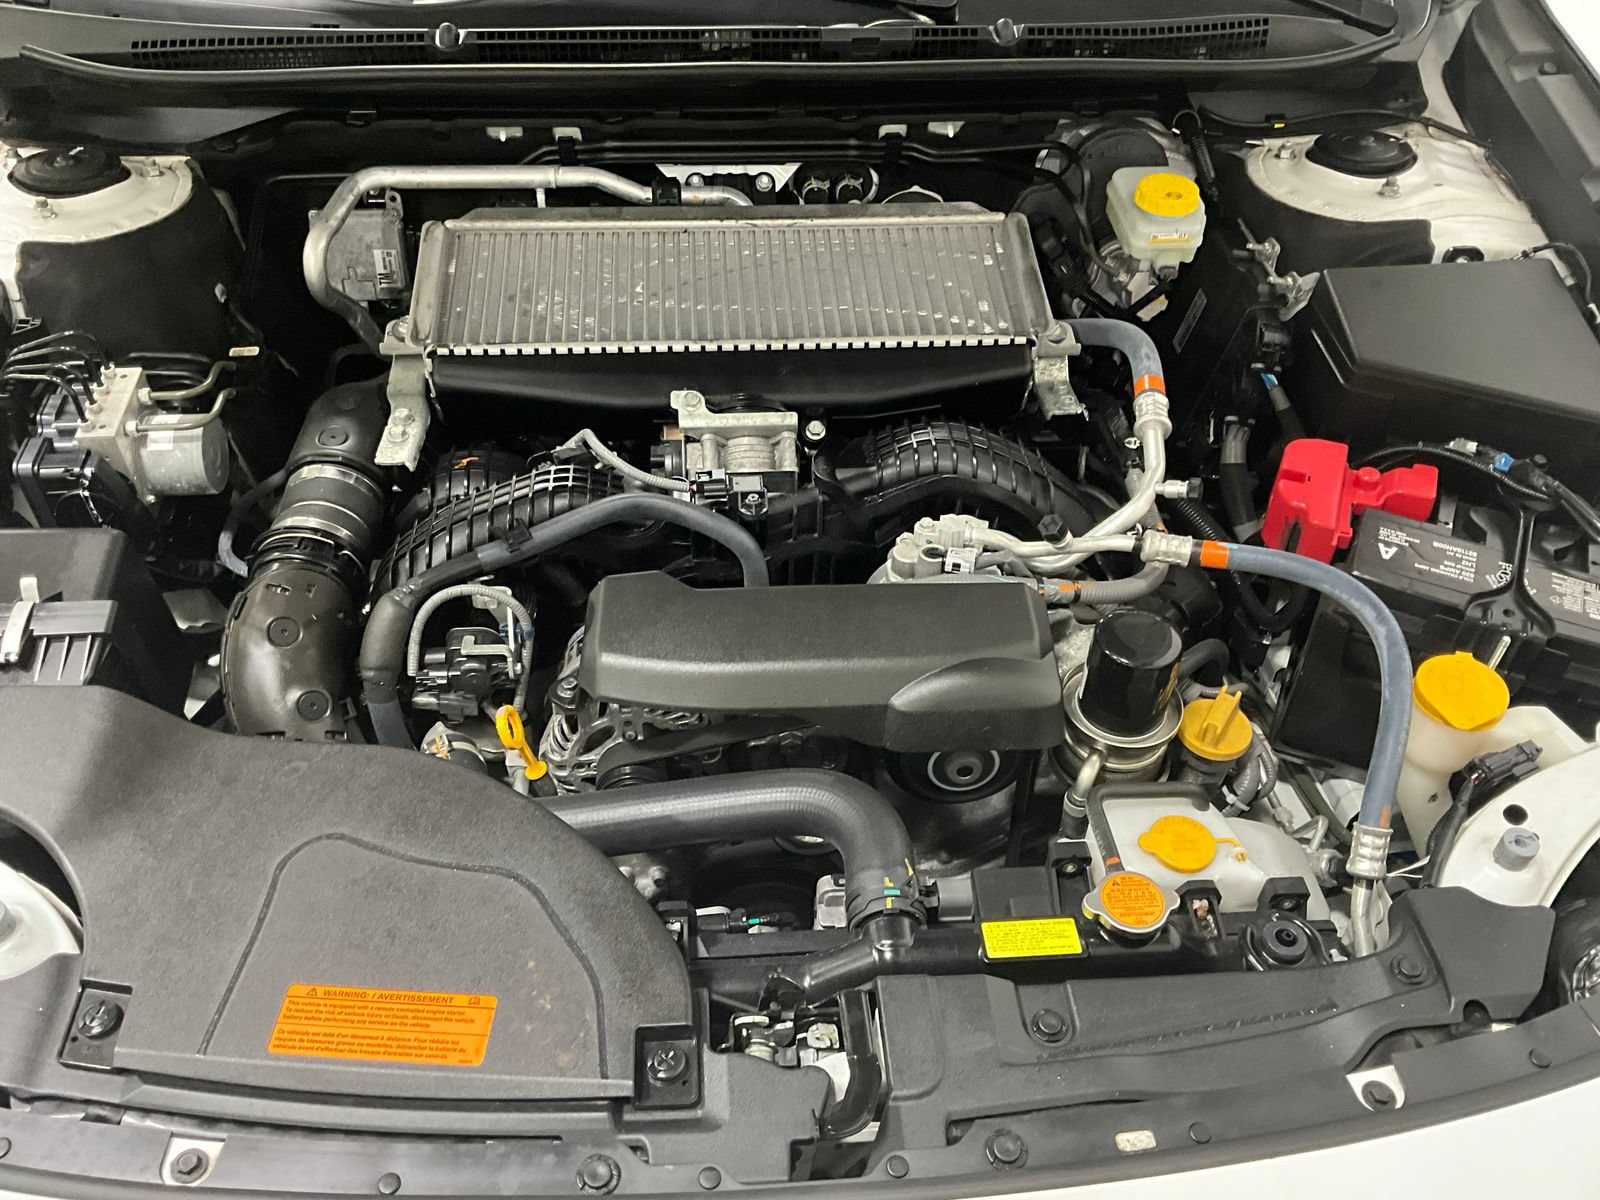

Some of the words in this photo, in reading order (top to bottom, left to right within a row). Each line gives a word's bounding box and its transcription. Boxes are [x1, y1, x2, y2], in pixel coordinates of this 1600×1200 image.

[323, 989, 370, 999] WARNING:
[377, 992, 455, 1004] AVERTISSEMENT
[426, 1008, 445, 1016] engine
